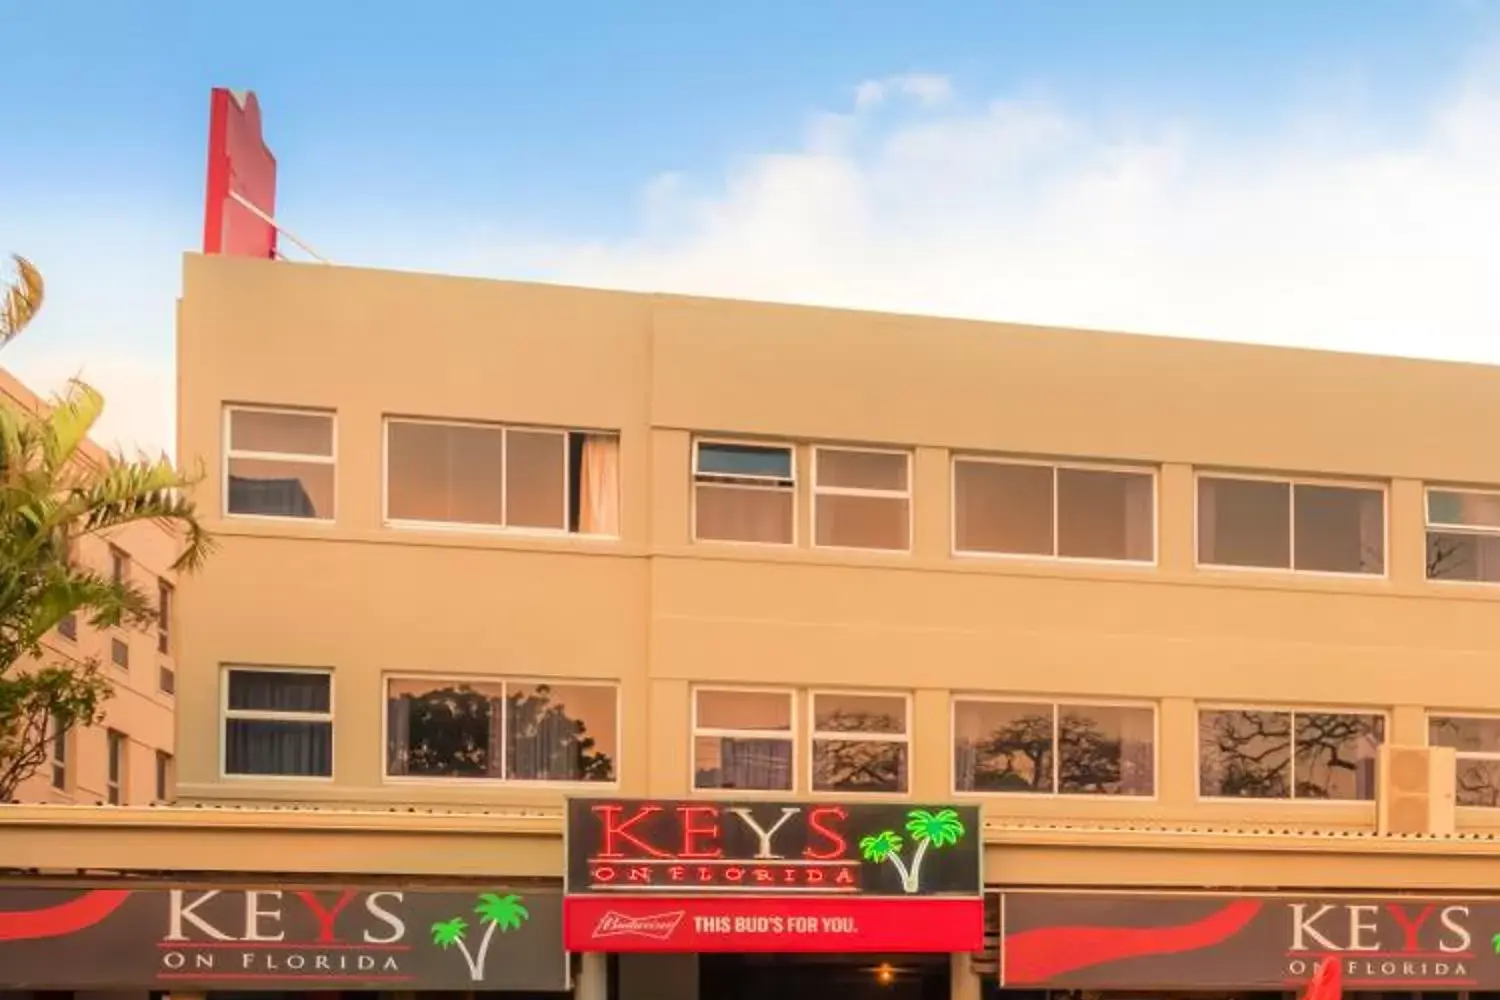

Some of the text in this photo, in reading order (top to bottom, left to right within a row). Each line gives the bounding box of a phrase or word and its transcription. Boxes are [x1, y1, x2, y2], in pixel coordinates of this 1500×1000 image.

[590, 805, 849, 861] KEYS
[594, 865, 853, 883] ON FLORIDA
[162, 888, 407, 944] KEYS
[693, 915, 859, 934] THIS BUD'S FOR YOU.
[1287, 902, 1472, 954] KEYS
[162, 952, 400, 972] ON FLORIDA
[1347, 961, 1467, 977] FLORIDA
